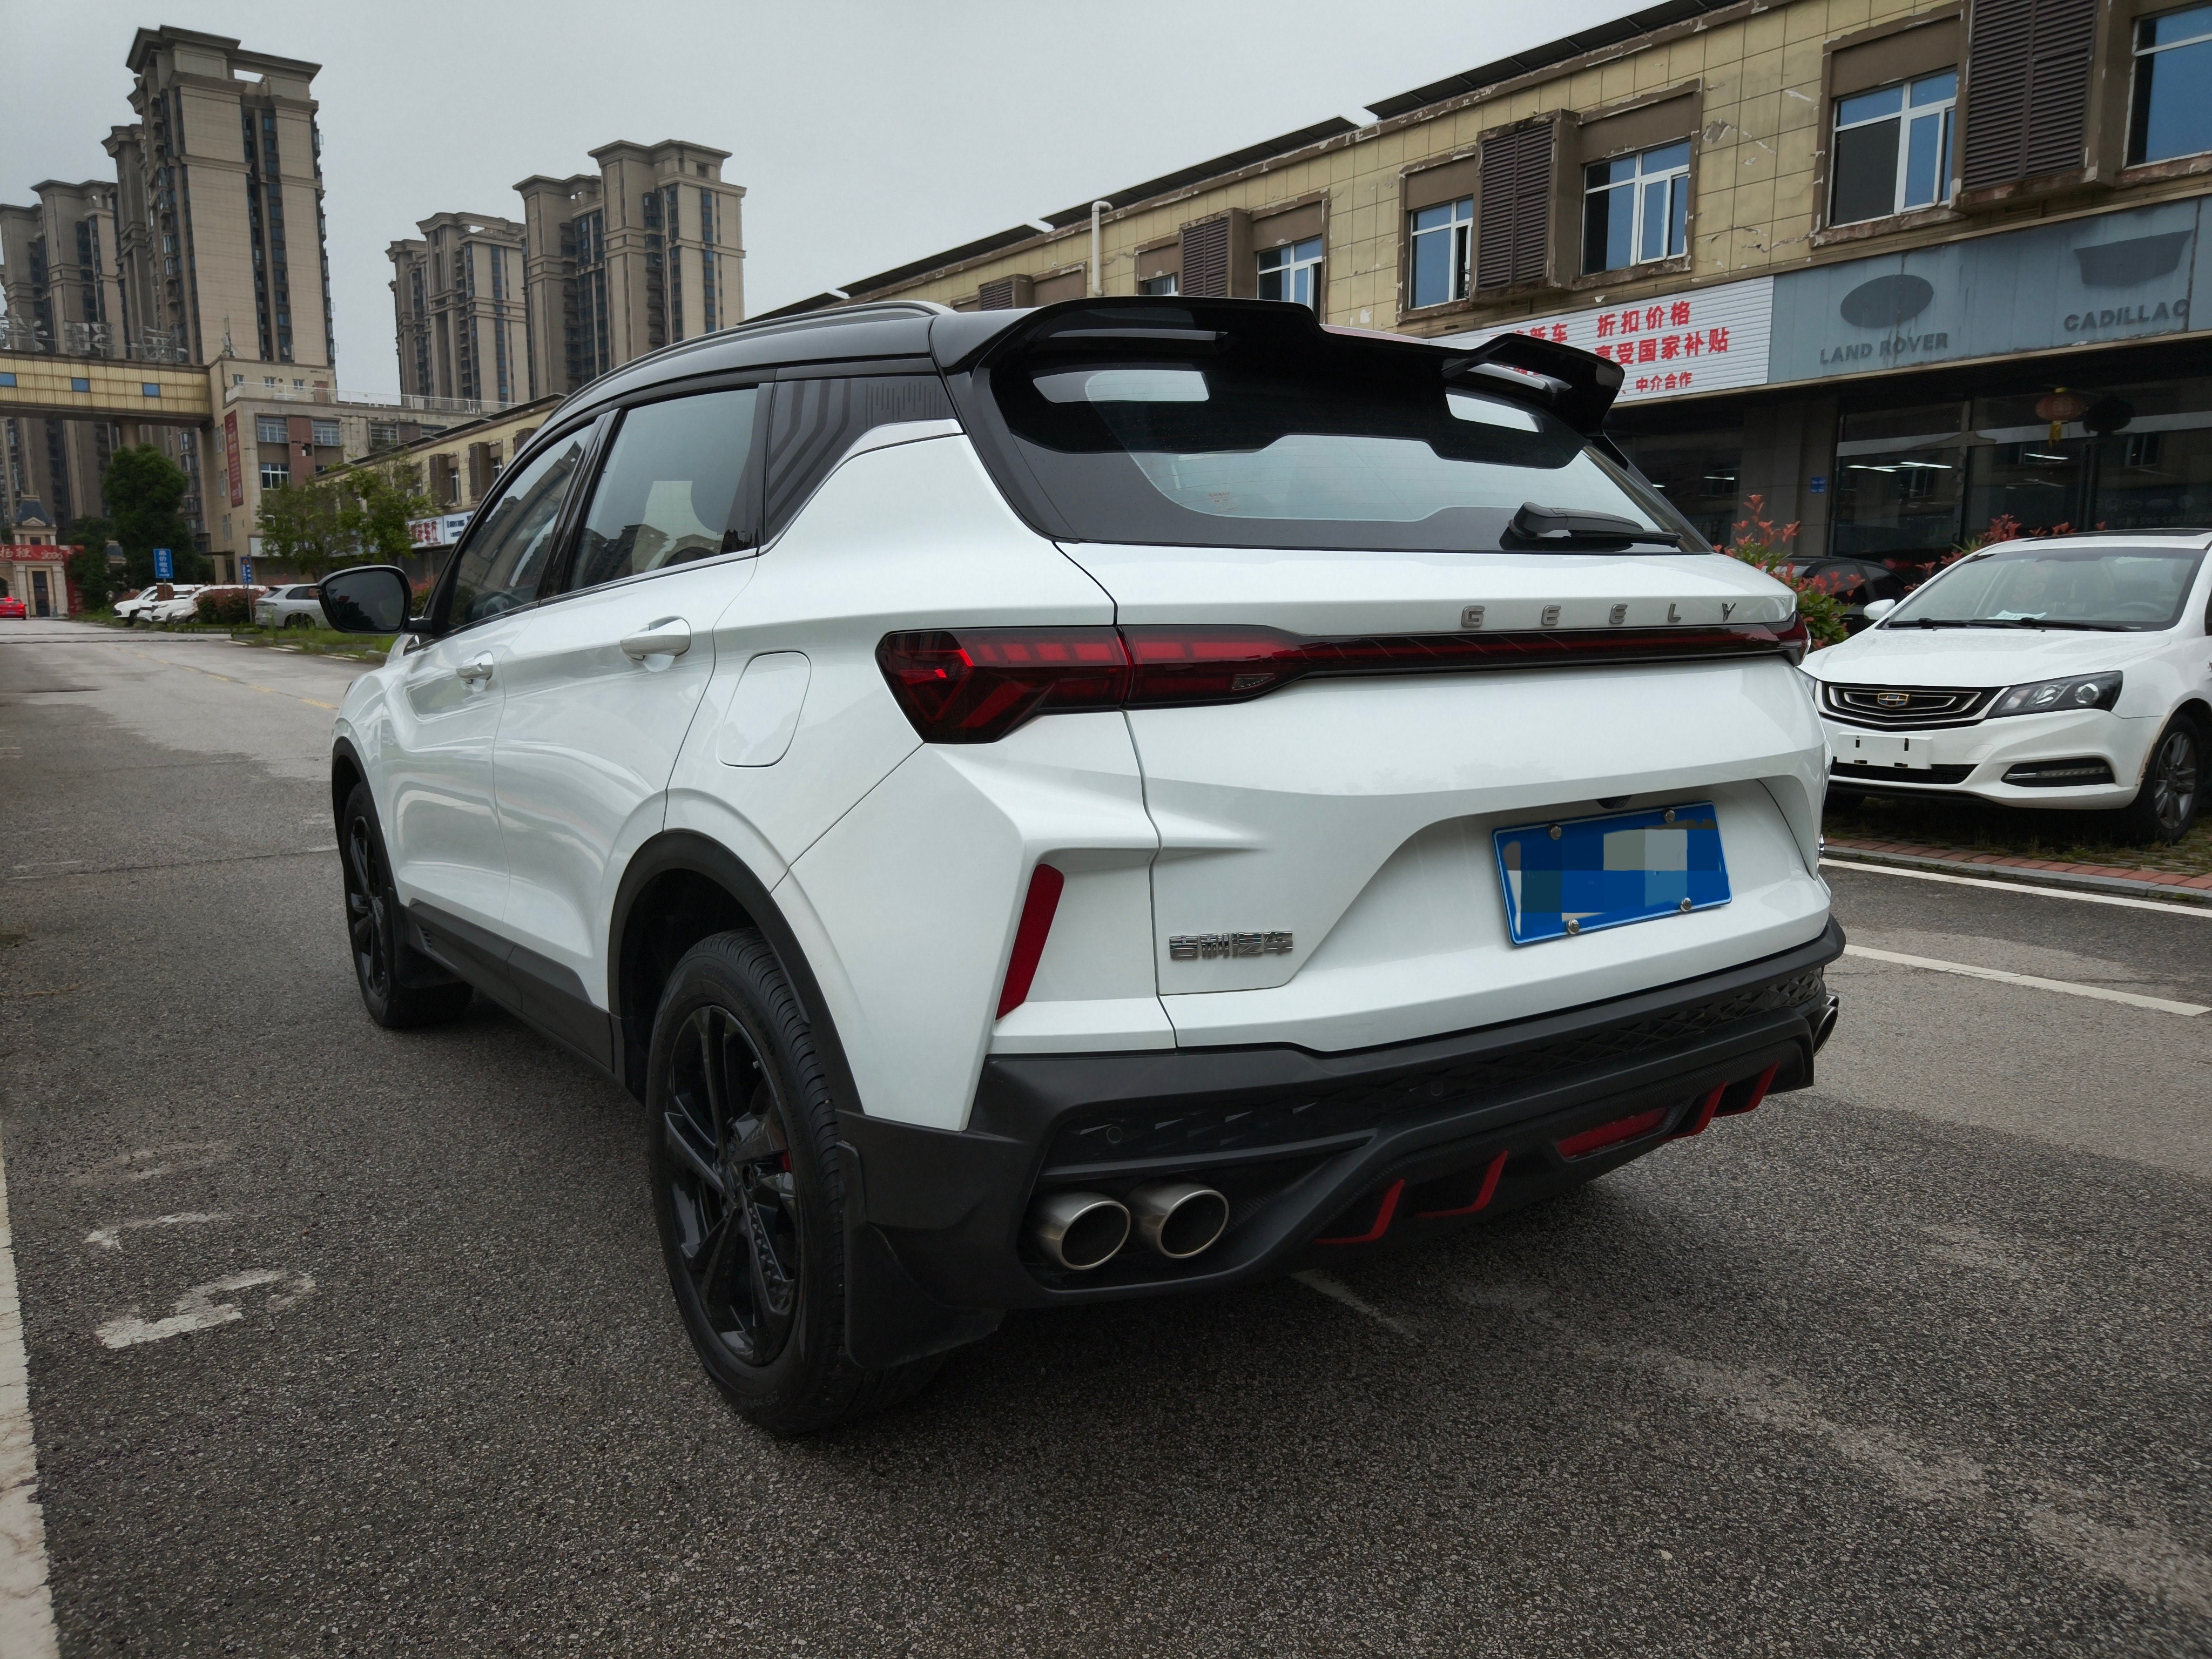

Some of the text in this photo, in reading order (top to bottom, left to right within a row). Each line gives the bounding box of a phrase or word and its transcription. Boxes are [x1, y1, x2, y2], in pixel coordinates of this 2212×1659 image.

[1597, 301, 1691, 338] 折扣价格
[2063, 299, 2189, 332] CADILLAC
[1819, 332, 1948, 365] LAND ROVER
[1461, 602, 1736, 628] GEELY
[1169, 930, 1293, 960] 吉利汽车
